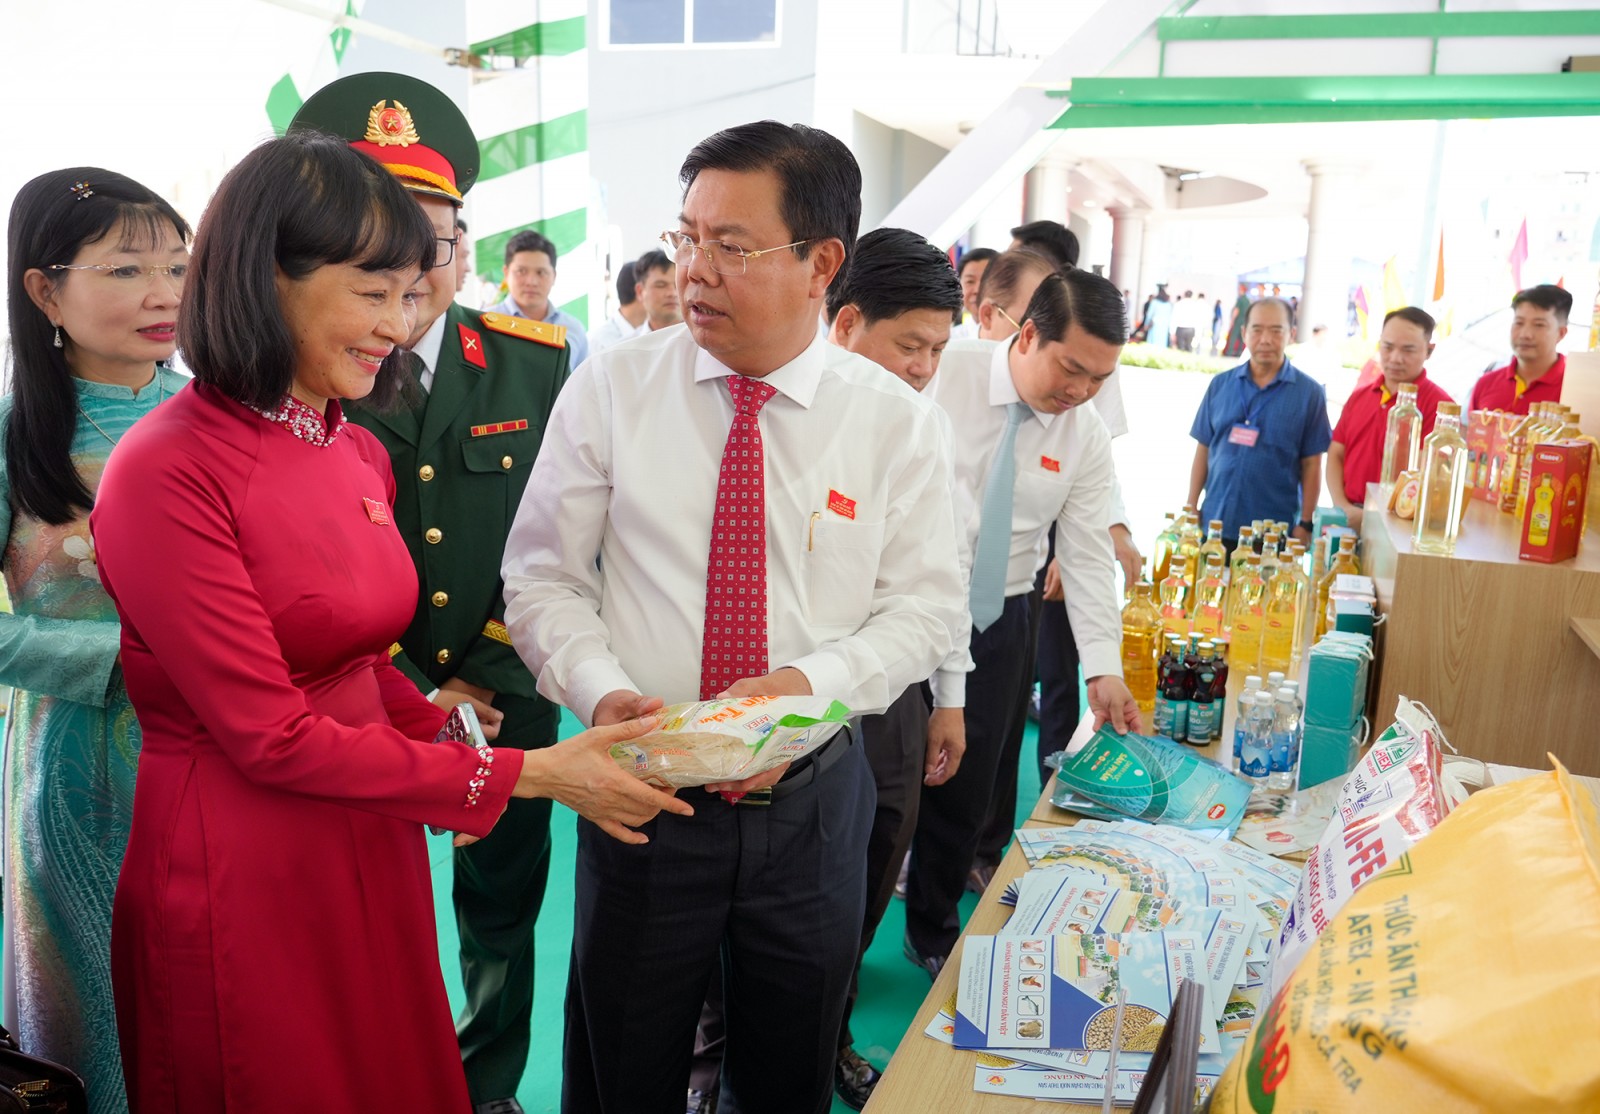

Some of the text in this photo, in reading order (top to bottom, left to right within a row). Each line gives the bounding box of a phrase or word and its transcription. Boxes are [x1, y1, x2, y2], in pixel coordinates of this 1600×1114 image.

[1384, 894, 1417, 941] THỨC
[1347, 914, 1373, 965] AFIEX
[1387, 941, 1420, 973] ĂN
[1348, 980, 1374, 1007] AN
